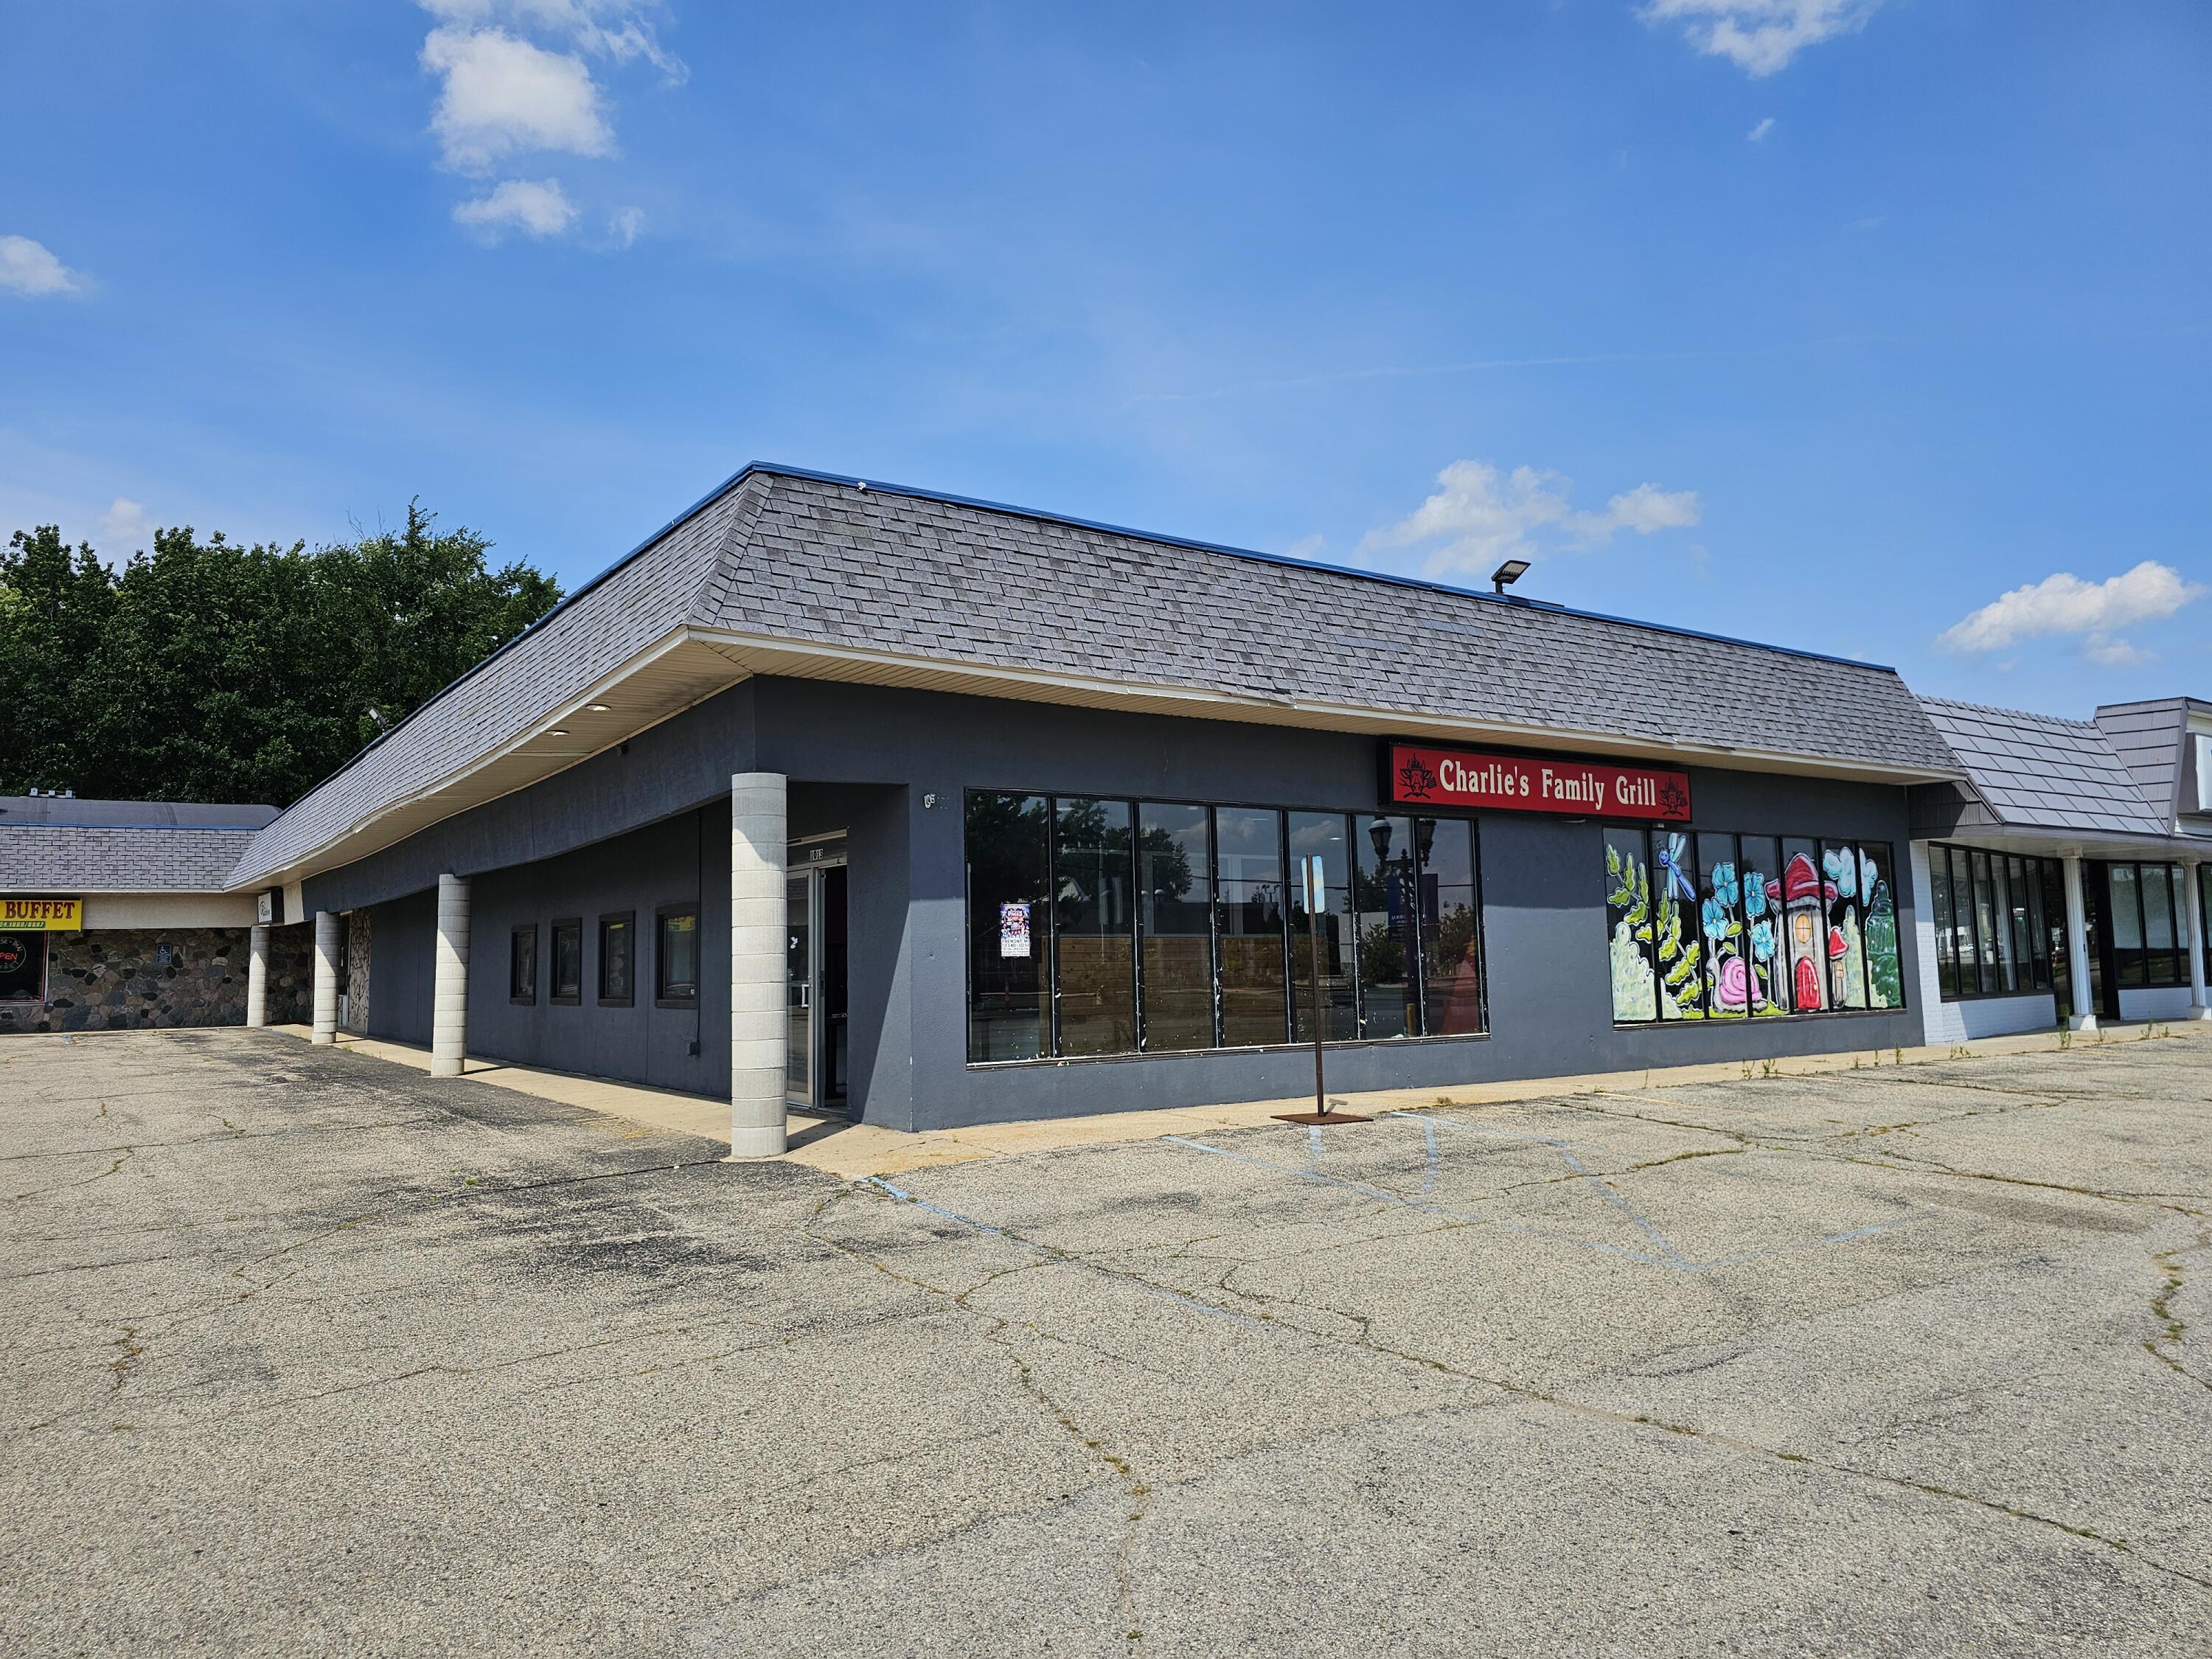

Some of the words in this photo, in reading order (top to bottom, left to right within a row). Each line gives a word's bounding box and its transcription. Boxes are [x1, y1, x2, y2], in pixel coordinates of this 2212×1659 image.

[1439, 759, 1529, 796] Charlie's
[1542, 768, 1604, 810] Family
[1616, 776, 1656, 807] Grill
[810, 849, 823, 860] 1013
[5, 901, 75, 919] BUFFET
